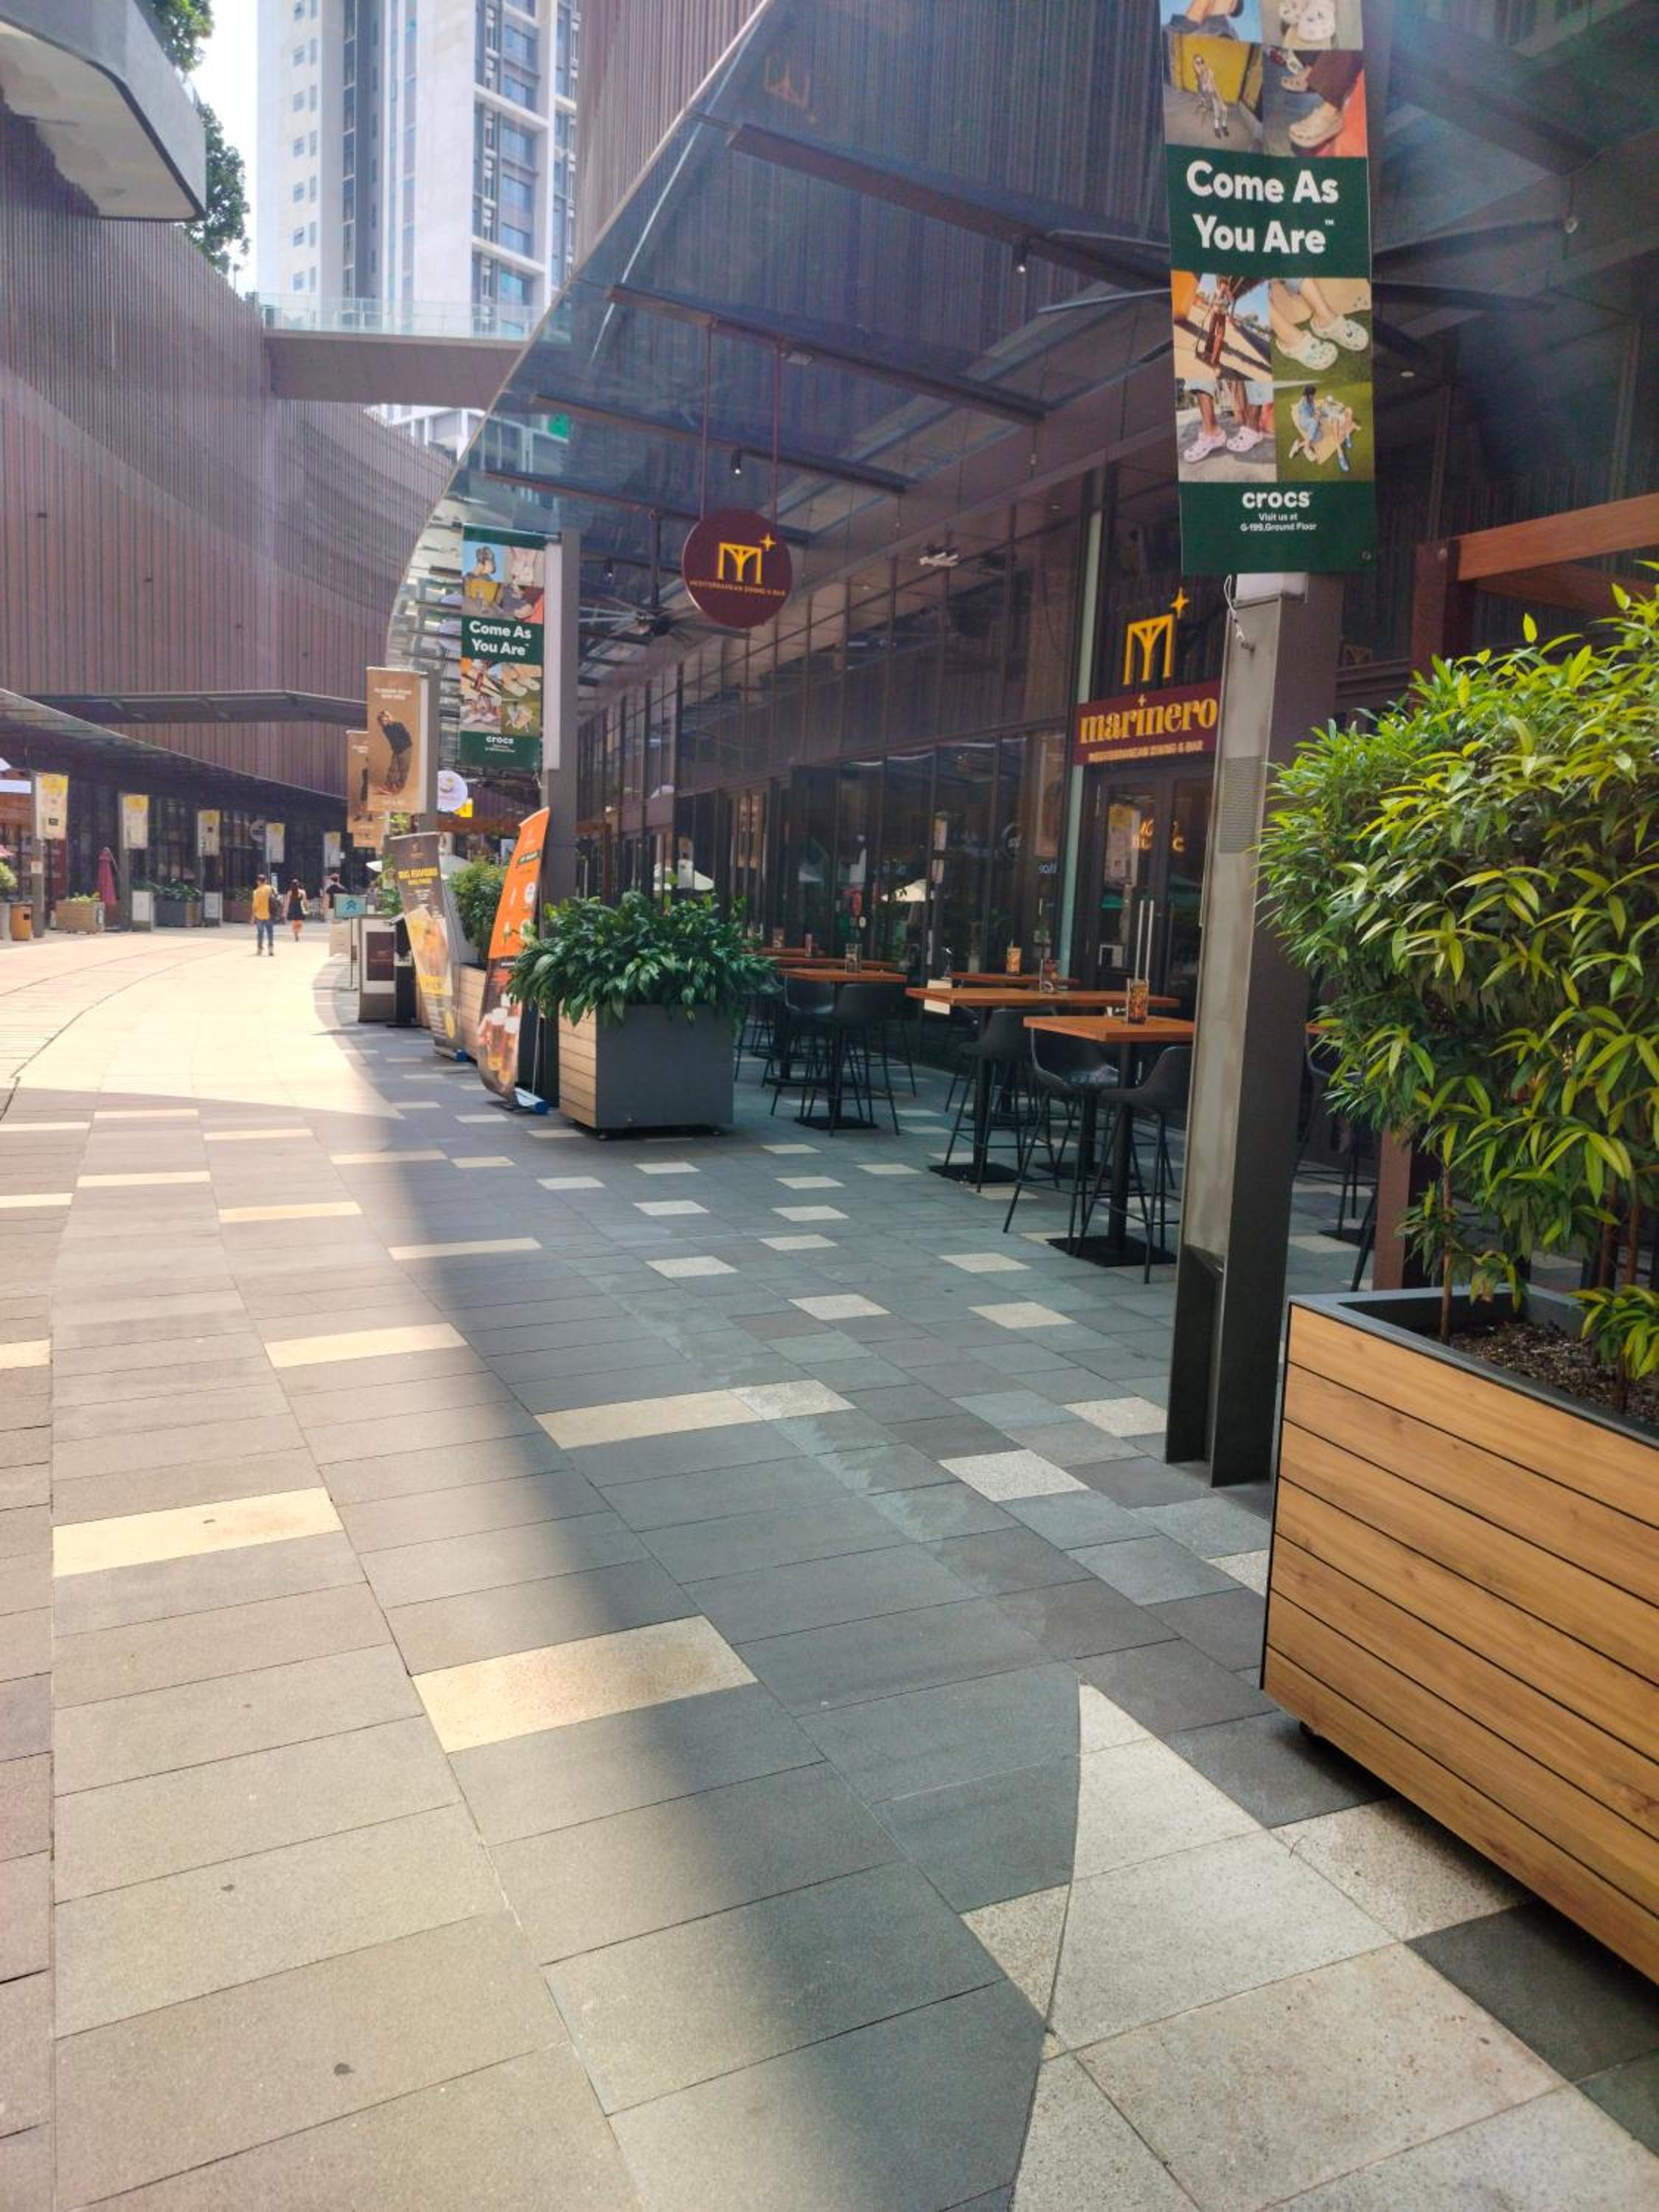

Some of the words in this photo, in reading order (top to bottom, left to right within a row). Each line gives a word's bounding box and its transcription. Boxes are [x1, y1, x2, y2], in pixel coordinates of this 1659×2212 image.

[1186, 161, 1284, 203] Come
[1293, 170, 1340, 205] As
[1192, 213, 1255, 253] You
[1242, 491, 1310, 509] crocs
[1296, 522, 1318, 530] Floor
[469, 620, 511, 637] Come
[513, 626, 532, 639] As
[471, 638, 498, 653] You
[1079, 696, 1218, 745] marinero
[486, 736, 514, 745] crocs
